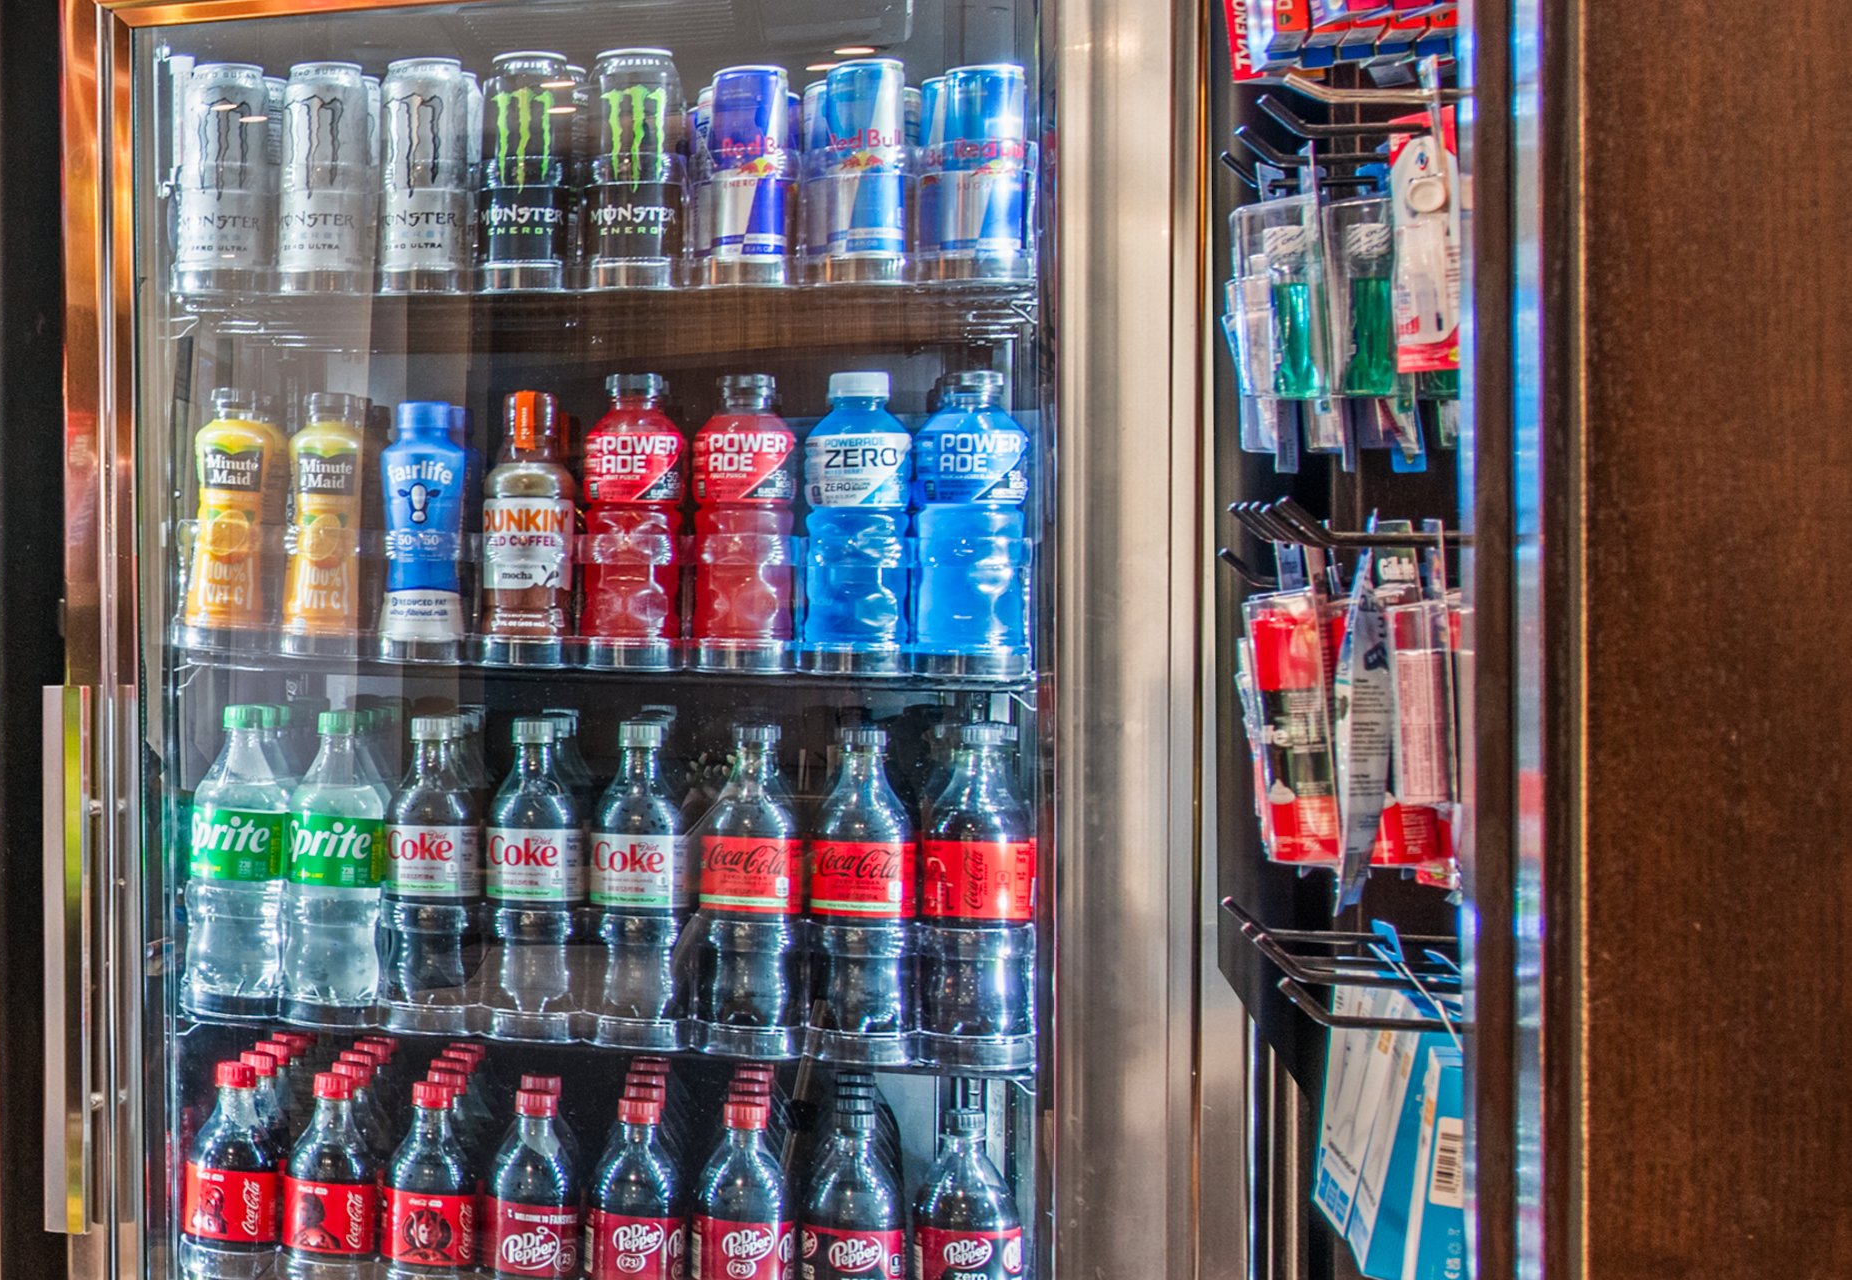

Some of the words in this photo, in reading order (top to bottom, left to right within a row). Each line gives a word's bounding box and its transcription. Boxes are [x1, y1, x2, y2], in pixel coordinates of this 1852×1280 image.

[721, 135, 761, 158] Red
[828, 129, 863, 153] Red
[867, 127, 902, 148] Bull
[480, 204, 564, 227] MONSTER
[590, 203, 676, 225] MONSTER
[487, 226, 555, 236] ENERGY
[600, 226, 668, 236] ENERGY
[602, 435, 678, 455] POWER
[709, 434, 787, 454] POWER
[824, 437, 886, 448] POWERADE
[206, 457, 258, 472] Minute
[301, 458, 353, 476] Minute
[601, 453, 647, 474] ADE
[709, 452, 756, 473] ADE
[824, 448, 899, 469] ZERO
[212, 470, 252, 486] Maid
[307, 474, 345, 489] Maid
[483, 508, 570, 533] DUNKIN'
[509, 534, 557, 548] COFFEE
[501, 570, 534, 582] mocha
[398, 596, 431, 607] REDUCED
[432, 597, 447, 607] FAT
[433, 608, 449, 617] milk
[192, 813, 271, 857] Sprite
[427, 830, 449, 842] Diet
[489, 834, 558, 868] Coke
[594, 841, 665, 875] Coke
[707, 841, 786, 877] Coca-Cola
[817, 846, 901, 881] Coca-Cola
[521, 1231, 545, 1251] Dr
[613, 1231, 663, 1254] Pepper
[502, 1239, 557, 1265] Pepper
